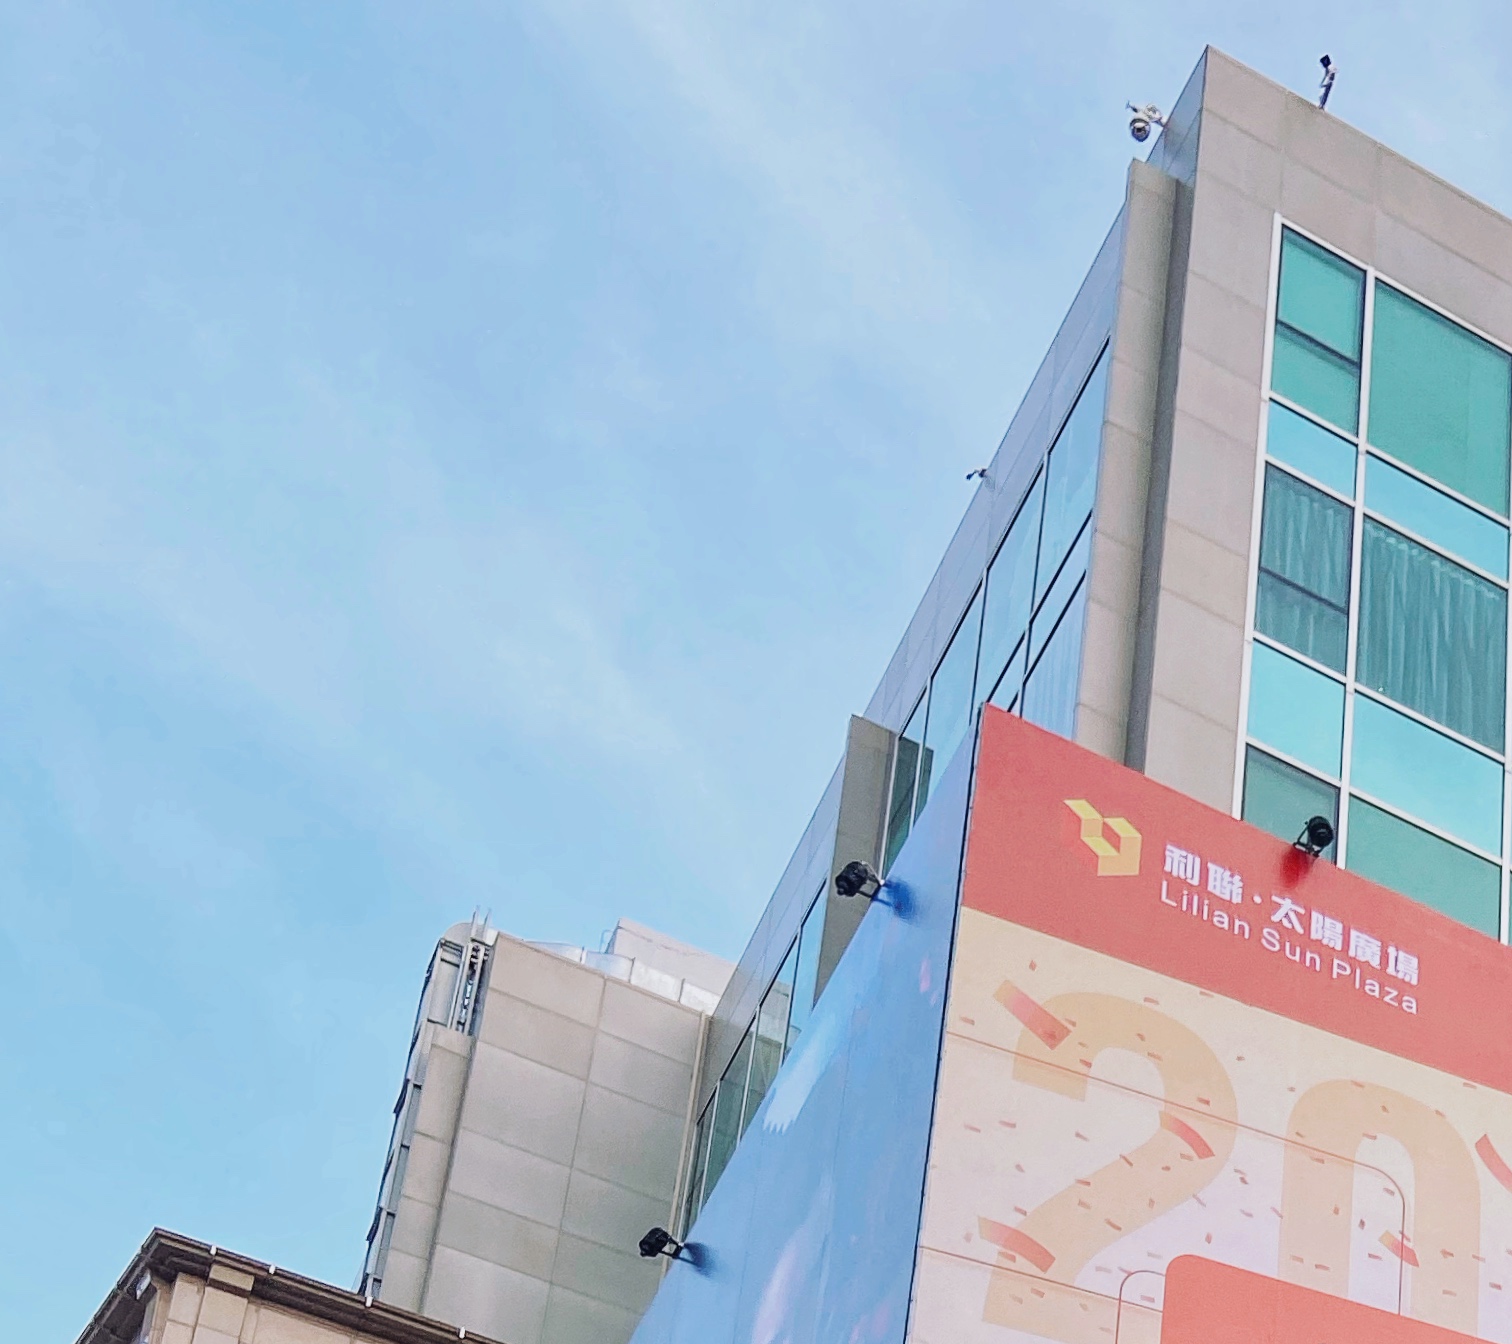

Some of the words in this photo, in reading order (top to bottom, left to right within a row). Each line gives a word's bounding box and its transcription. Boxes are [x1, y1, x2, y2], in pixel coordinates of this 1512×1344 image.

[1160, 879, 1251, 940] Lilian
[1260, 926, 1322, 972] Sun
[1331, 956, 1418, 1016] Plaza
